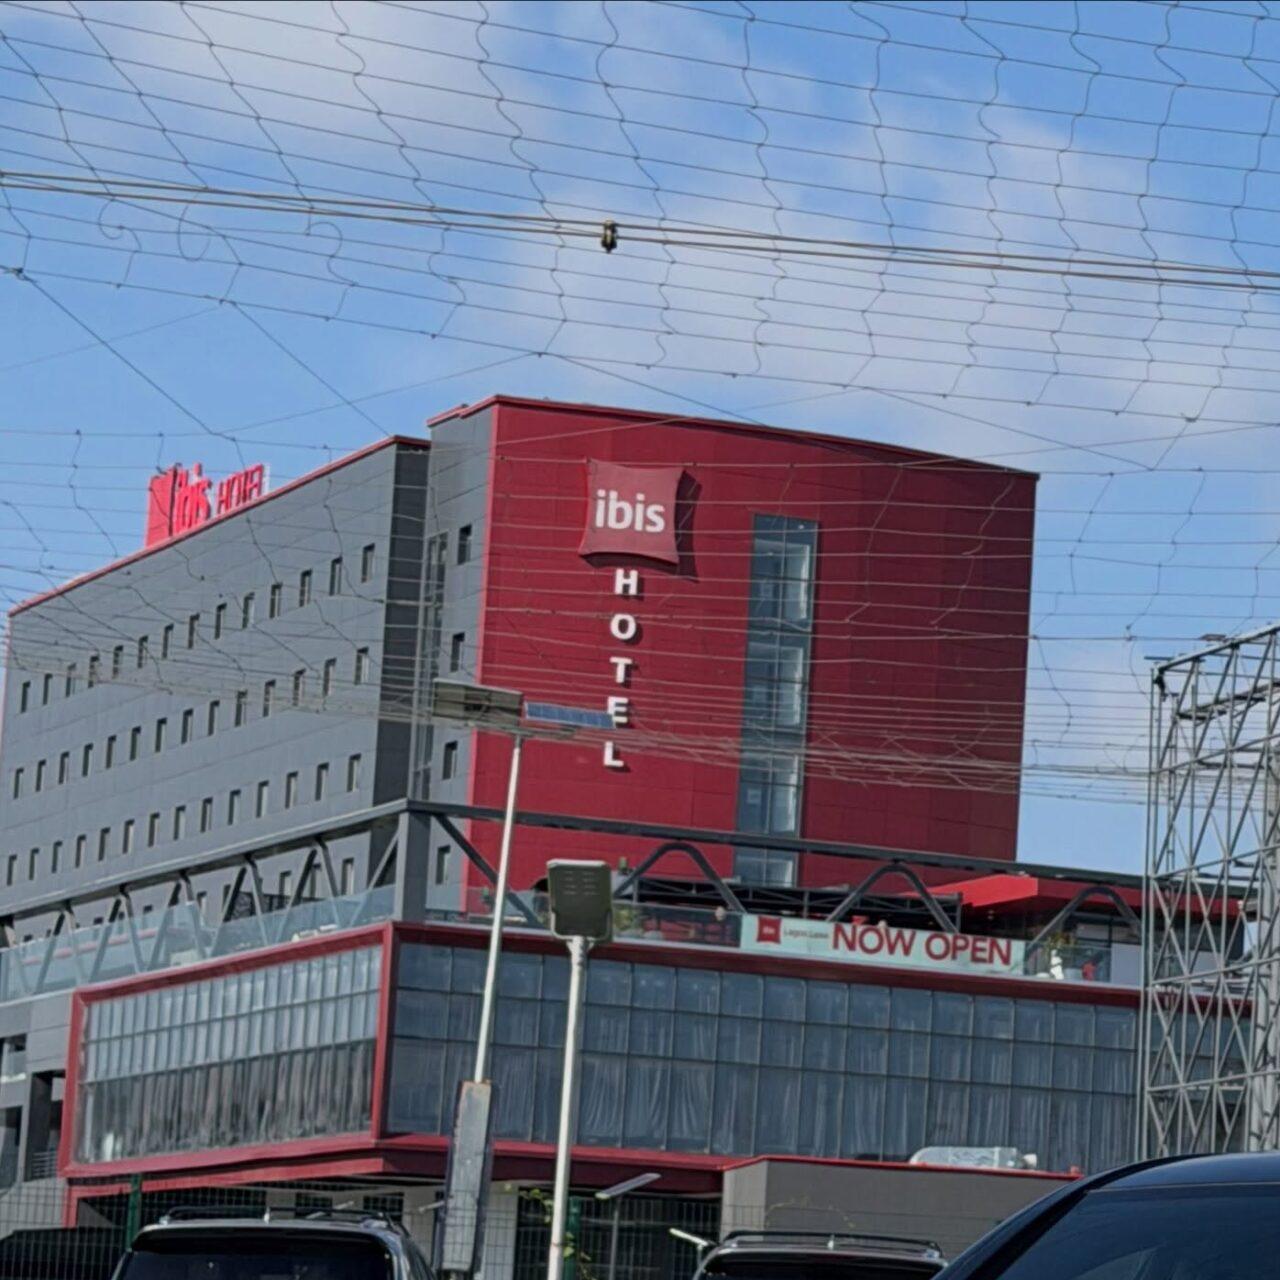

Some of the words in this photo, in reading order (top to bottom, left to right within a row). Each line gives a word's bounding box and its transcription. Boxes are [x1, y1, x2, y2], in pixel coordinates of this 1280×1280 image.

[595, 489, 665, 533] ibis
[603, 568, 638, 767] HOTEL
[832, 923, 916, 956] NOW
[925, 933, 1012, 966] OPEN
